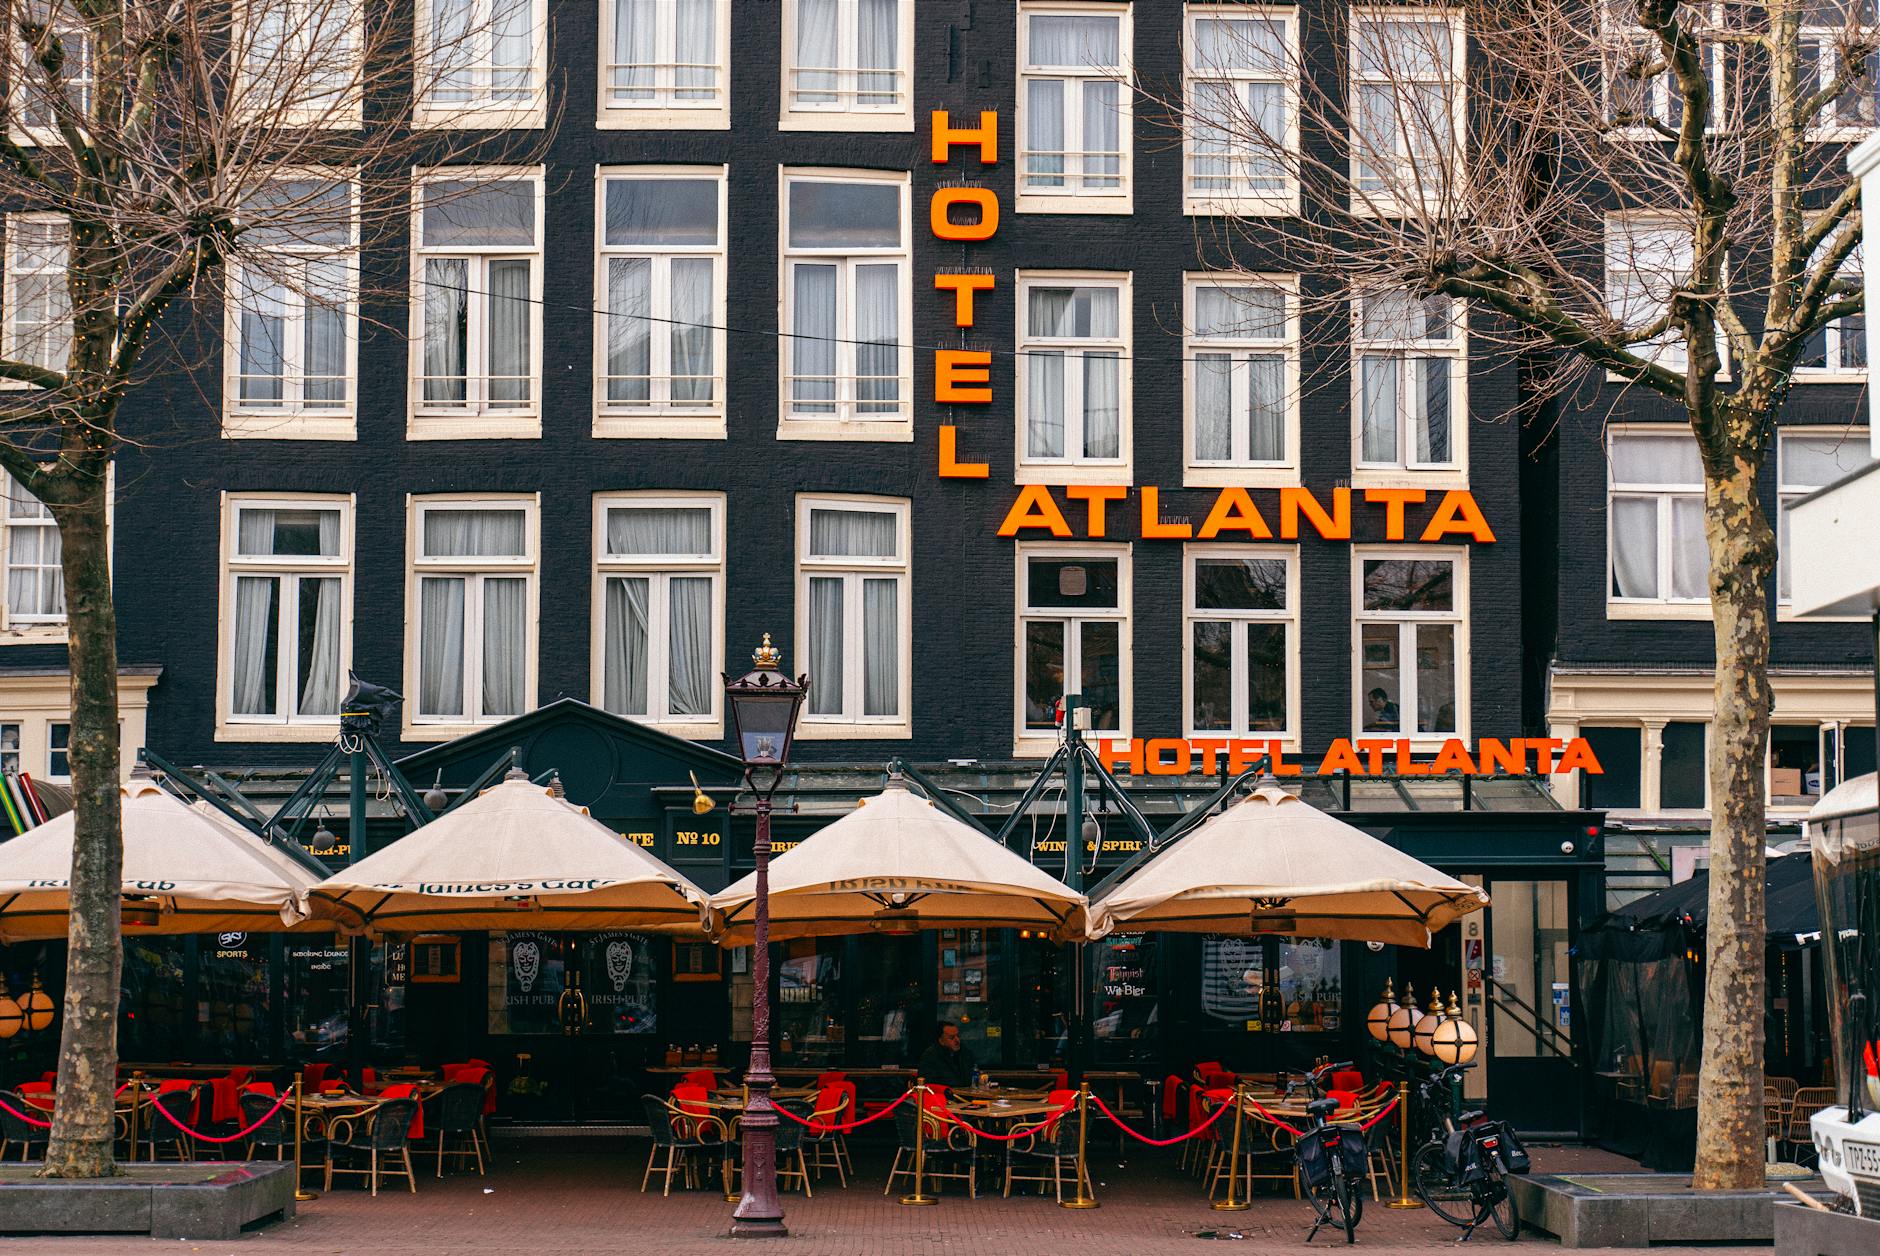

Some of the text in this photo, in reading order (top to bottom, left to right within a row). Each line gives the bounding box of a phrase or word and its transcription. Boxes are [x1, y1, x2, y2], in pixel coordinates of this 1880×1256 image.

[931, 110, 999, 479] HOTEL
[997, 484, 1497, 543] ATLANTA
[1099, 736, 1604, 776] HOTEL ATLANTA
[701, 832, 720, 845] 10
[1087, 840, 1099, 851] &
[1468, 922, 1478, 937] 8
[216, 950, 249, 959] SPORTS
[1124, 984, 1146, 997] Bier
[532, 994, 555, 1005] PUB
